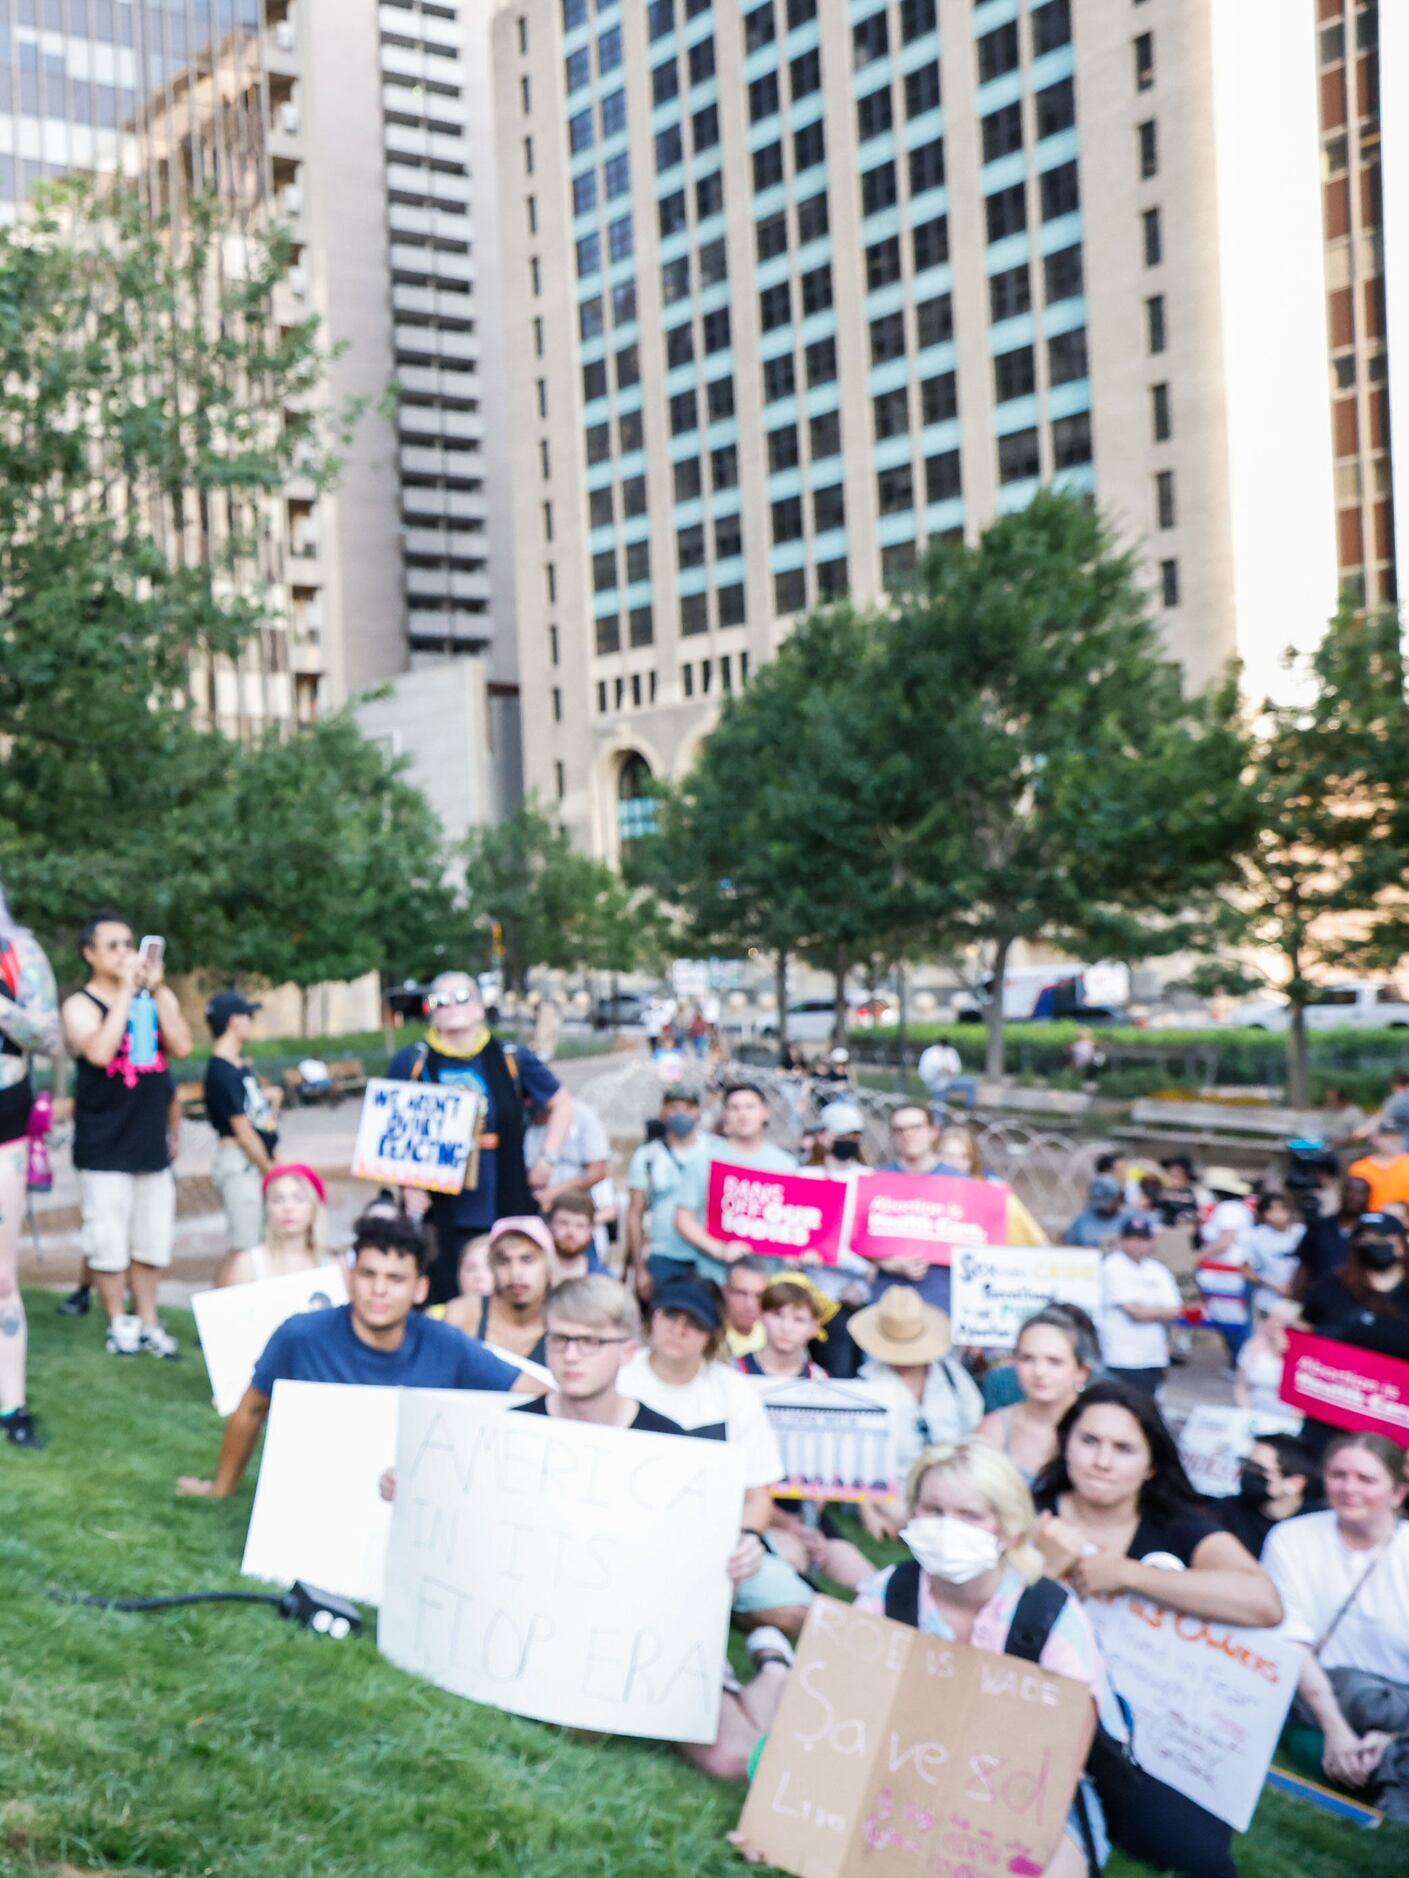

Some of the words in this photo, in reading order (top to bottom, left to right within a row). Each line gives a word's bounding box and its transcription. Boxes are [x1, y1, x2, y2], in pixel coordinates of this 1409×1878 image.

[375, 1089, 400, 1111] WE
[724, 1175, 786, 1205] BANS
[763, 1200, 823, 1231] OUR
[721, 1211, 811, 1247] BODIES
[407, 1410, 707, 1515] AMERICA
[408, 1497, 461, 1567] IN
[496, 1519, 618, 1592] ITS
[412, 1575, 558, 1685] FLOP
[580, 1625, 712, 1716] ERA
[811, 1600, 913, 1672] ROE
